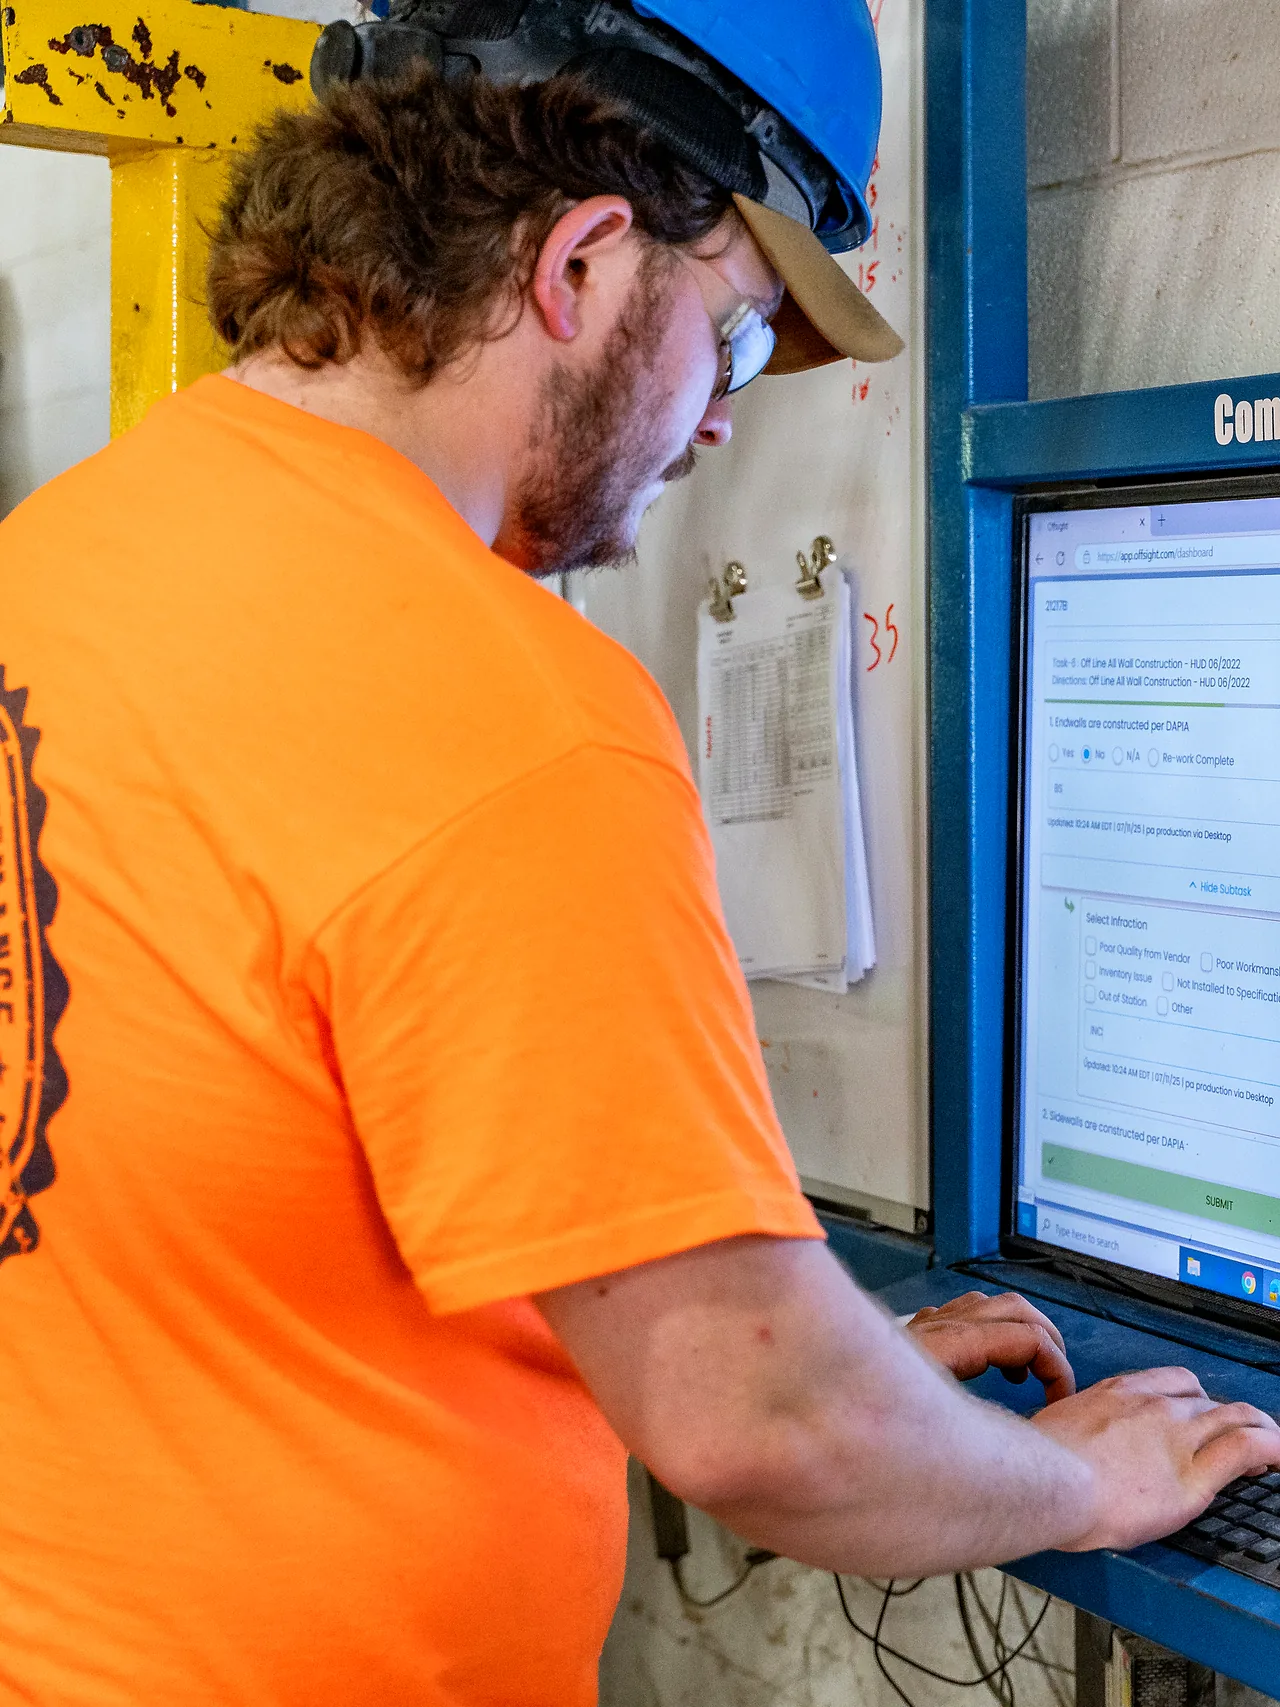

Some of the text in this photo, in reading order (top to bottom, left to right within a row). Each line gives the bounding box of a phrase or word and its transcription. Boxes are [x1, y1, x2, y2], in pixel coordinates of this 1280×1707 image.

[1097, 546, 1214, 564] https://app.offsight.com/dashboard
[1081, 657, 1091, 668] Off
[1092, 657, 1106, 668] Line
[1108, 658, 1116, 668] All
[1118, 658, 1134, 668] Wall
[1135, 658, 1182, 669] Construction
[1190, 659, 1206, 669] HUD
[1209, 658, 1241, 671] 06/2022
[1089, 676, 1099, 686] Off
[1100, 676, 1114, 686] Line
[1116, 676, 1125, 686] All
[1126, 676, 1142, 686] Wall
[1144, 676, 1192, 688] Construction
[1200, 677, 1215, 688] HUD
[1218, 676, 1250, 689] 06/2022
[1055, 717, 1087, 728] Endwalls
[1089, 720, 1100, 729] are
[1103, 719, 1149, 730] constructed
[1151, 722, 1164, 733] per
[1166, 721, 1189, 732] DAPIA
[1062, 748, 1234, 768] Yes No N/A Re-work Complete
[1091, 820, 1100, 829] AM
[1116, 823, 1141, 835] 07/11/25
[1146, 827, 1155, 837] pa
[1157, 826, 1192, 838] production
[1193, 829, 1203, 838] via
[1204, 830, 1231, 842] Desktop
[1201, 882, 1251, 897] Hide Subtask
[1086, 913, 1147, 930] Select Infraction
[1100, 942, 1190, 964] Poor Quality from Vendor
[1217, 958, 1234, 970] Poor
[1099, 966, 1152, 983] Inventory Issue
[1177, 979, 1190, 990] Not
[1192, 980, 1224, 994] Installed
[1226, 985, 1234, 996] to
[1099, 991, 1147, 1007] Out of Station
[1172, 1003, 1192, 1015] Other
[1112, 1064, 1126, 1074] 10:24
[1128, 1068, 1137, 1077] AM
[1139, 1071, 1150, 1079] EDT
[1155, 1072, 1180, 1086] 07/11/25
[1185, 1079, 1194, 1090] pa
[1196, 1081, 1232, 1098] production
[1234, 1088, 1244, 1099] via
[1246, 1091, 1274, 1106] Desktop
[1050, 1111, 1082, 1128] Sidewalls
[1085, 1120, 1097, 1131] are
[1099, 1122, 1144, 1142] constructed
[1147, 1132, 1160, 1146] per
[1162, 1136, 1185, 1151] DAPIA
[1206, 1195, 1233, 1211] SUBMIT
[1056, 1224, 1119, 1251] Type here to search
